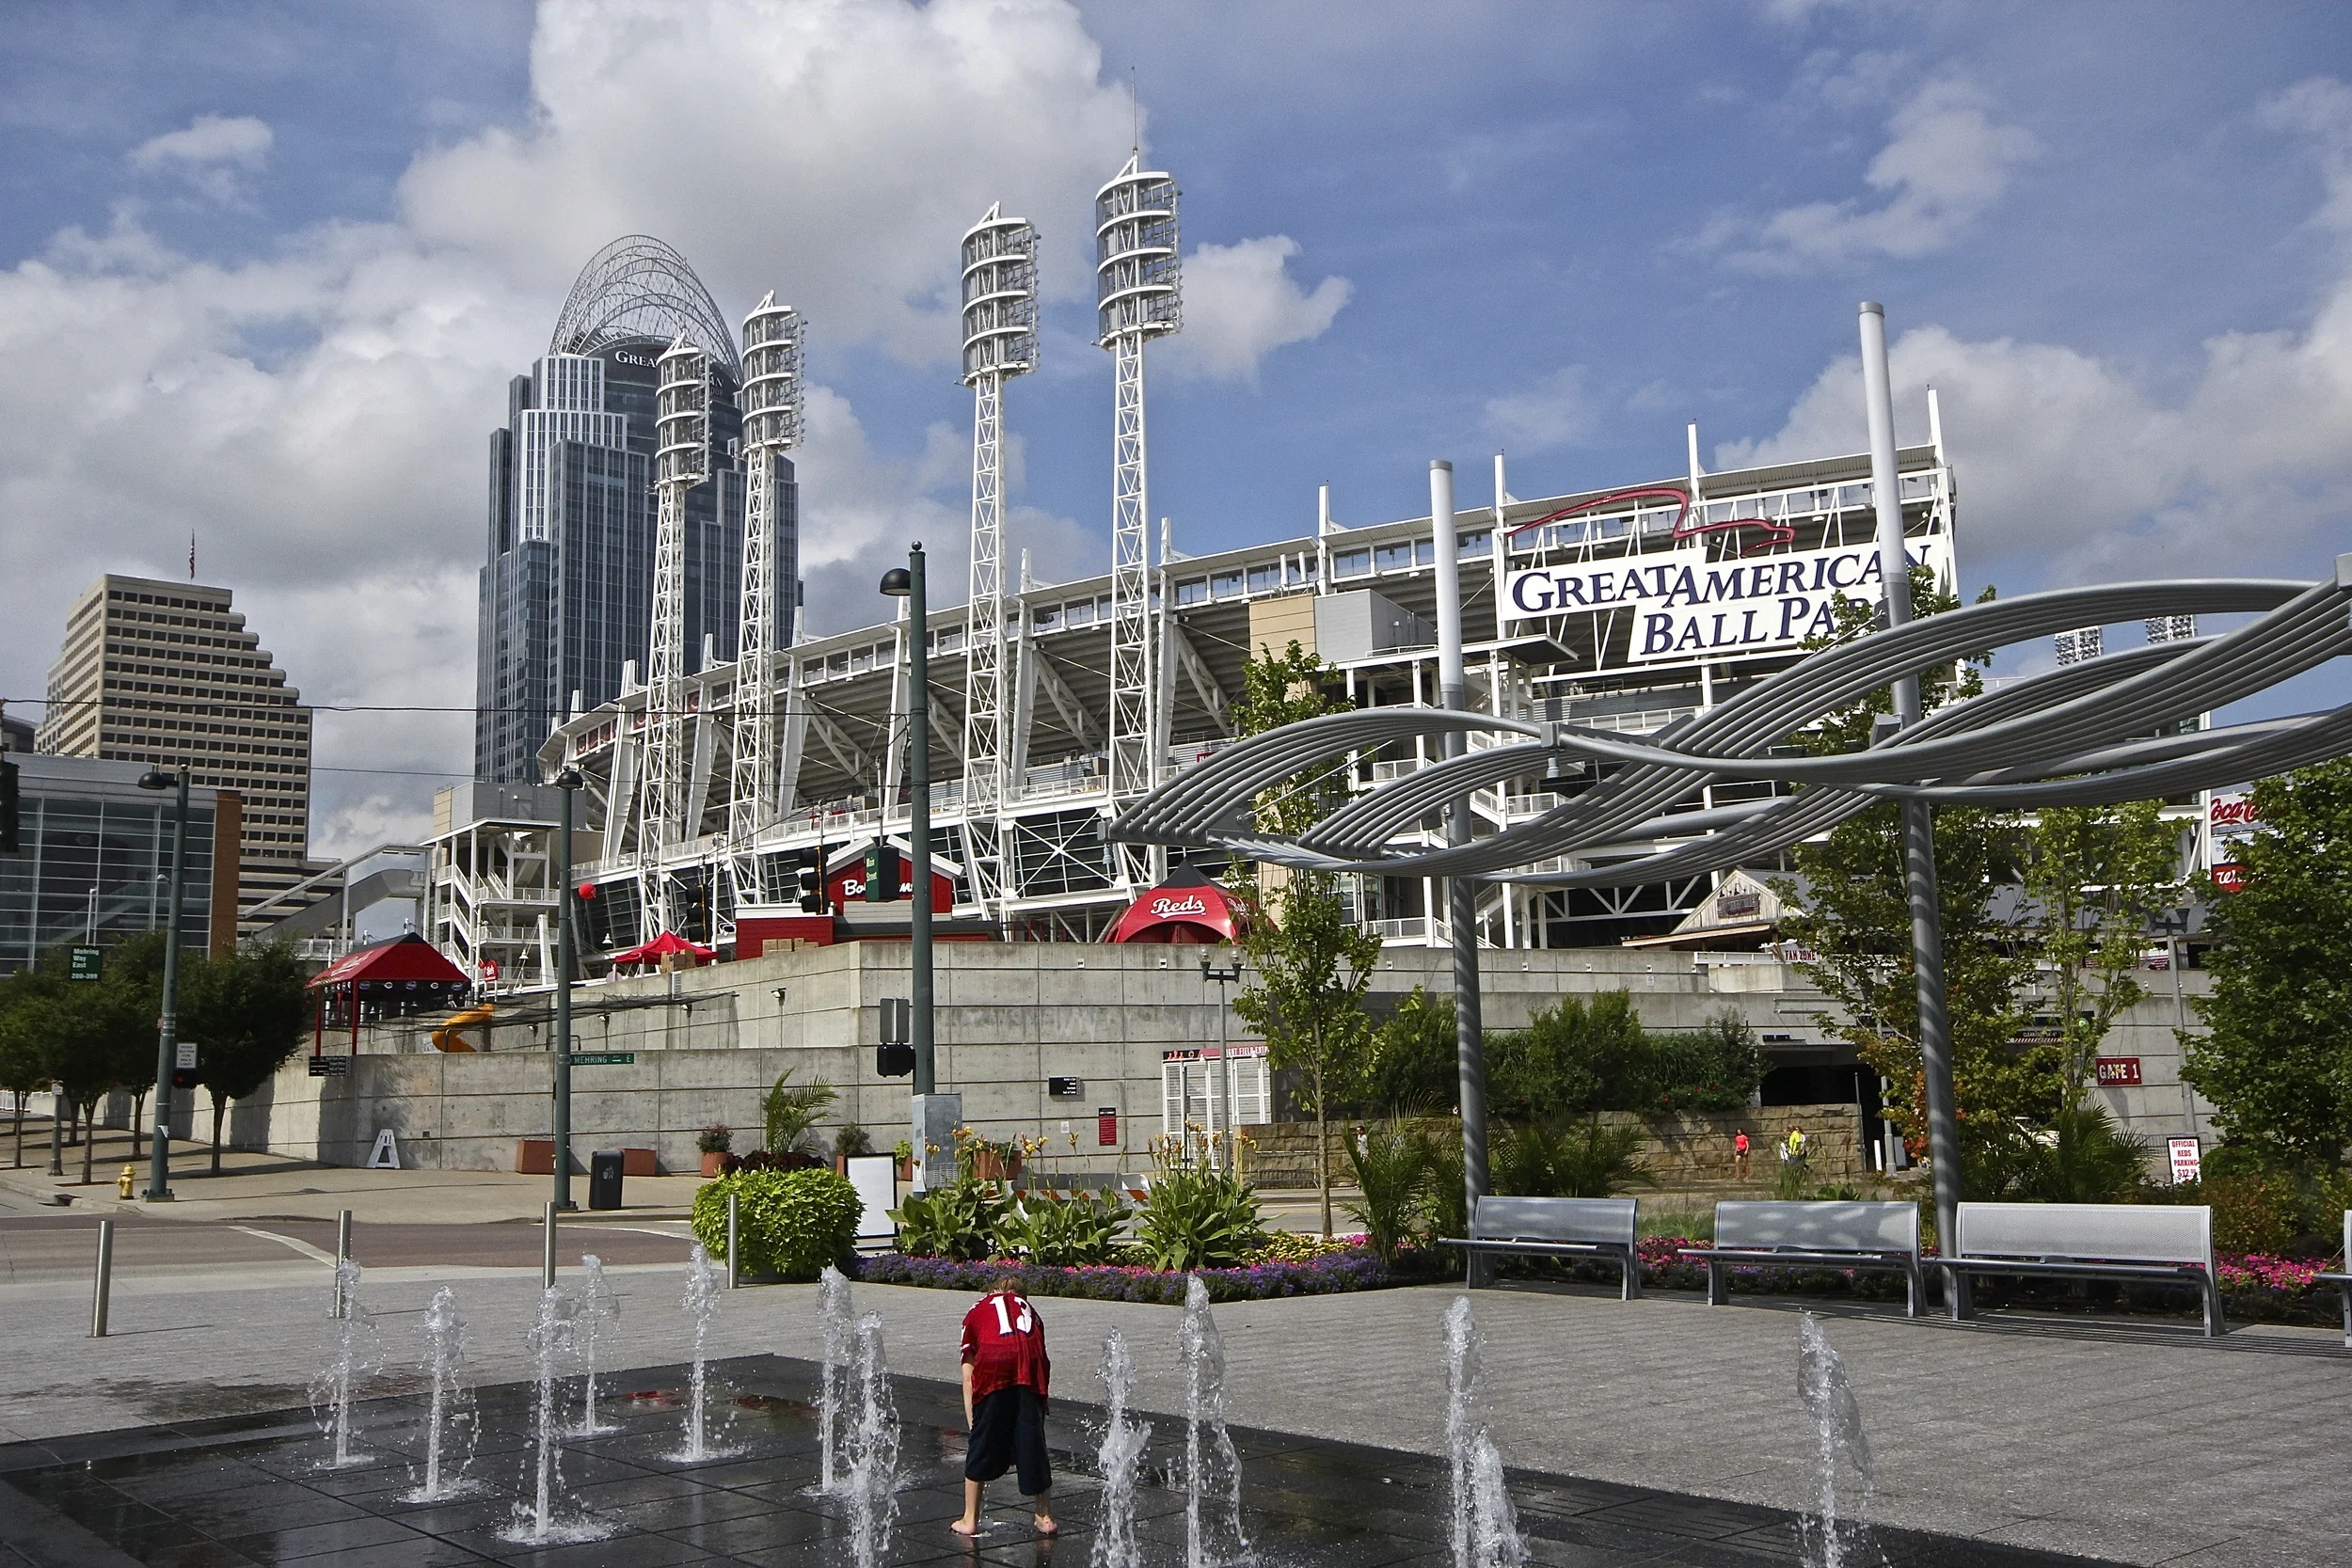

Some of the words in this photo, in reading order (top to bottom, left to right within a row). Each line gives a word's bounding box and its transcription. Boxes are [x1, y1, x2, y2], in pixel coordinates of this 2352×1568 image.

[614, 351, 657, 368] GREA
[1513, 563, 1677, 611] GREAT
[1641, 610, 1769, 655] BALL
[1150, 895, 1207, 919] Reds
[1786, 950, 1797, 959] FAN
[1800, 950, 1816, 959] ZONE
[575, 1055, 607, 1064] MEHRING
[1226, 1048, 1237, 1056] IGHT
[1239, 1047, 1254, 1055] FIELD
[2099, 1064, 2128, 1080] GATE
[2132, 1063, 2139, 1079] 1
[989, 1295, 1032, 1335] 13
